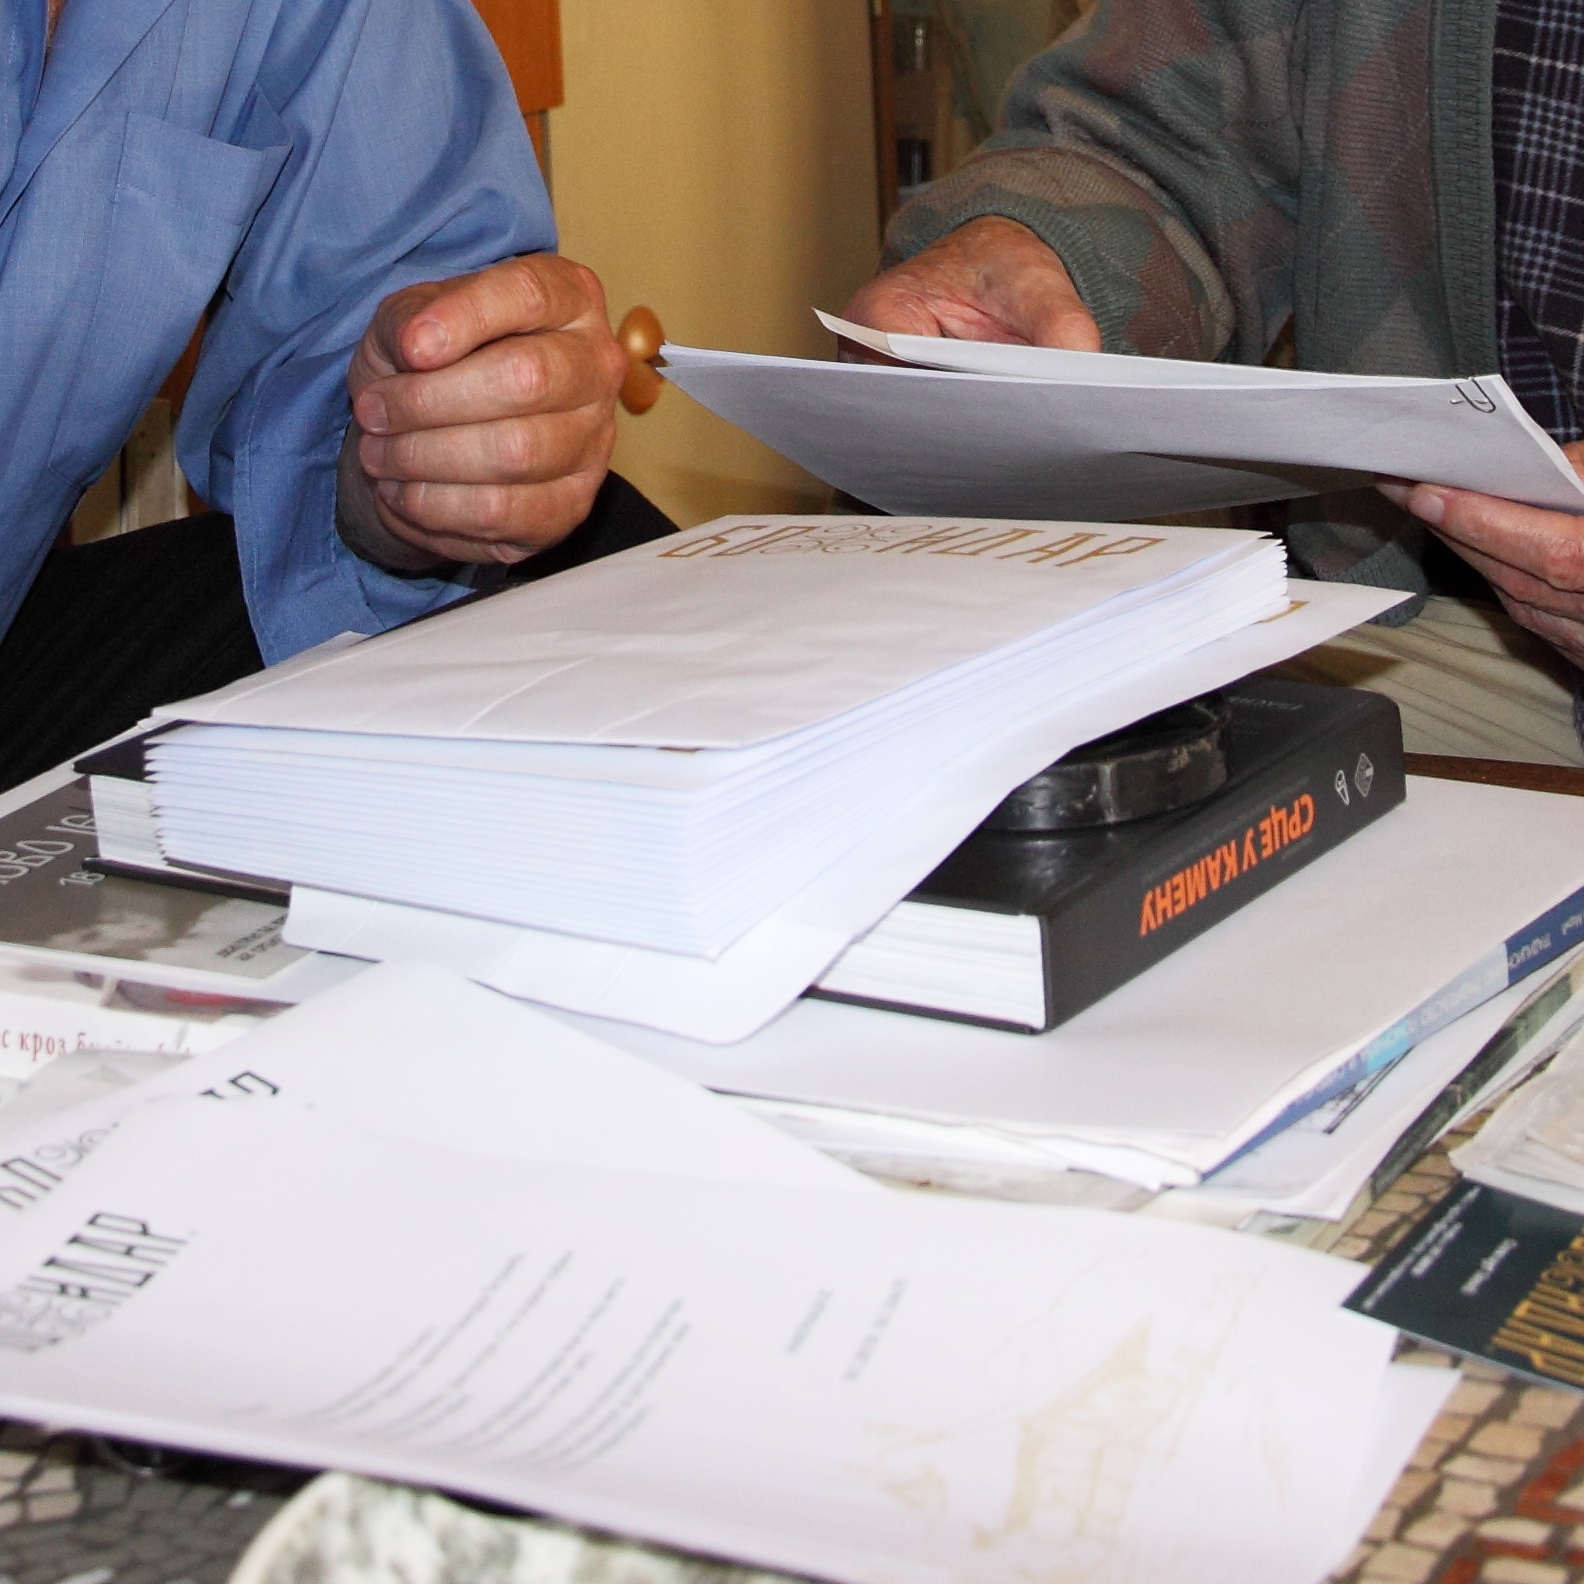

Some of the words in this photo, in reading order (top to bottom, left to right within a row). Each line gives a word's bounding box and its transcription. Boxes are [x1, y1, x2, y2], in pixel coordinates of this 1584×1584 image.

[1240, 828, 1260, 872] У
[1258, 793, 1316, 860] СРЦЕ
[1139, 841, 1240, 936] КАМЕНУ
[19, 1031, 68, 1062] кроз
